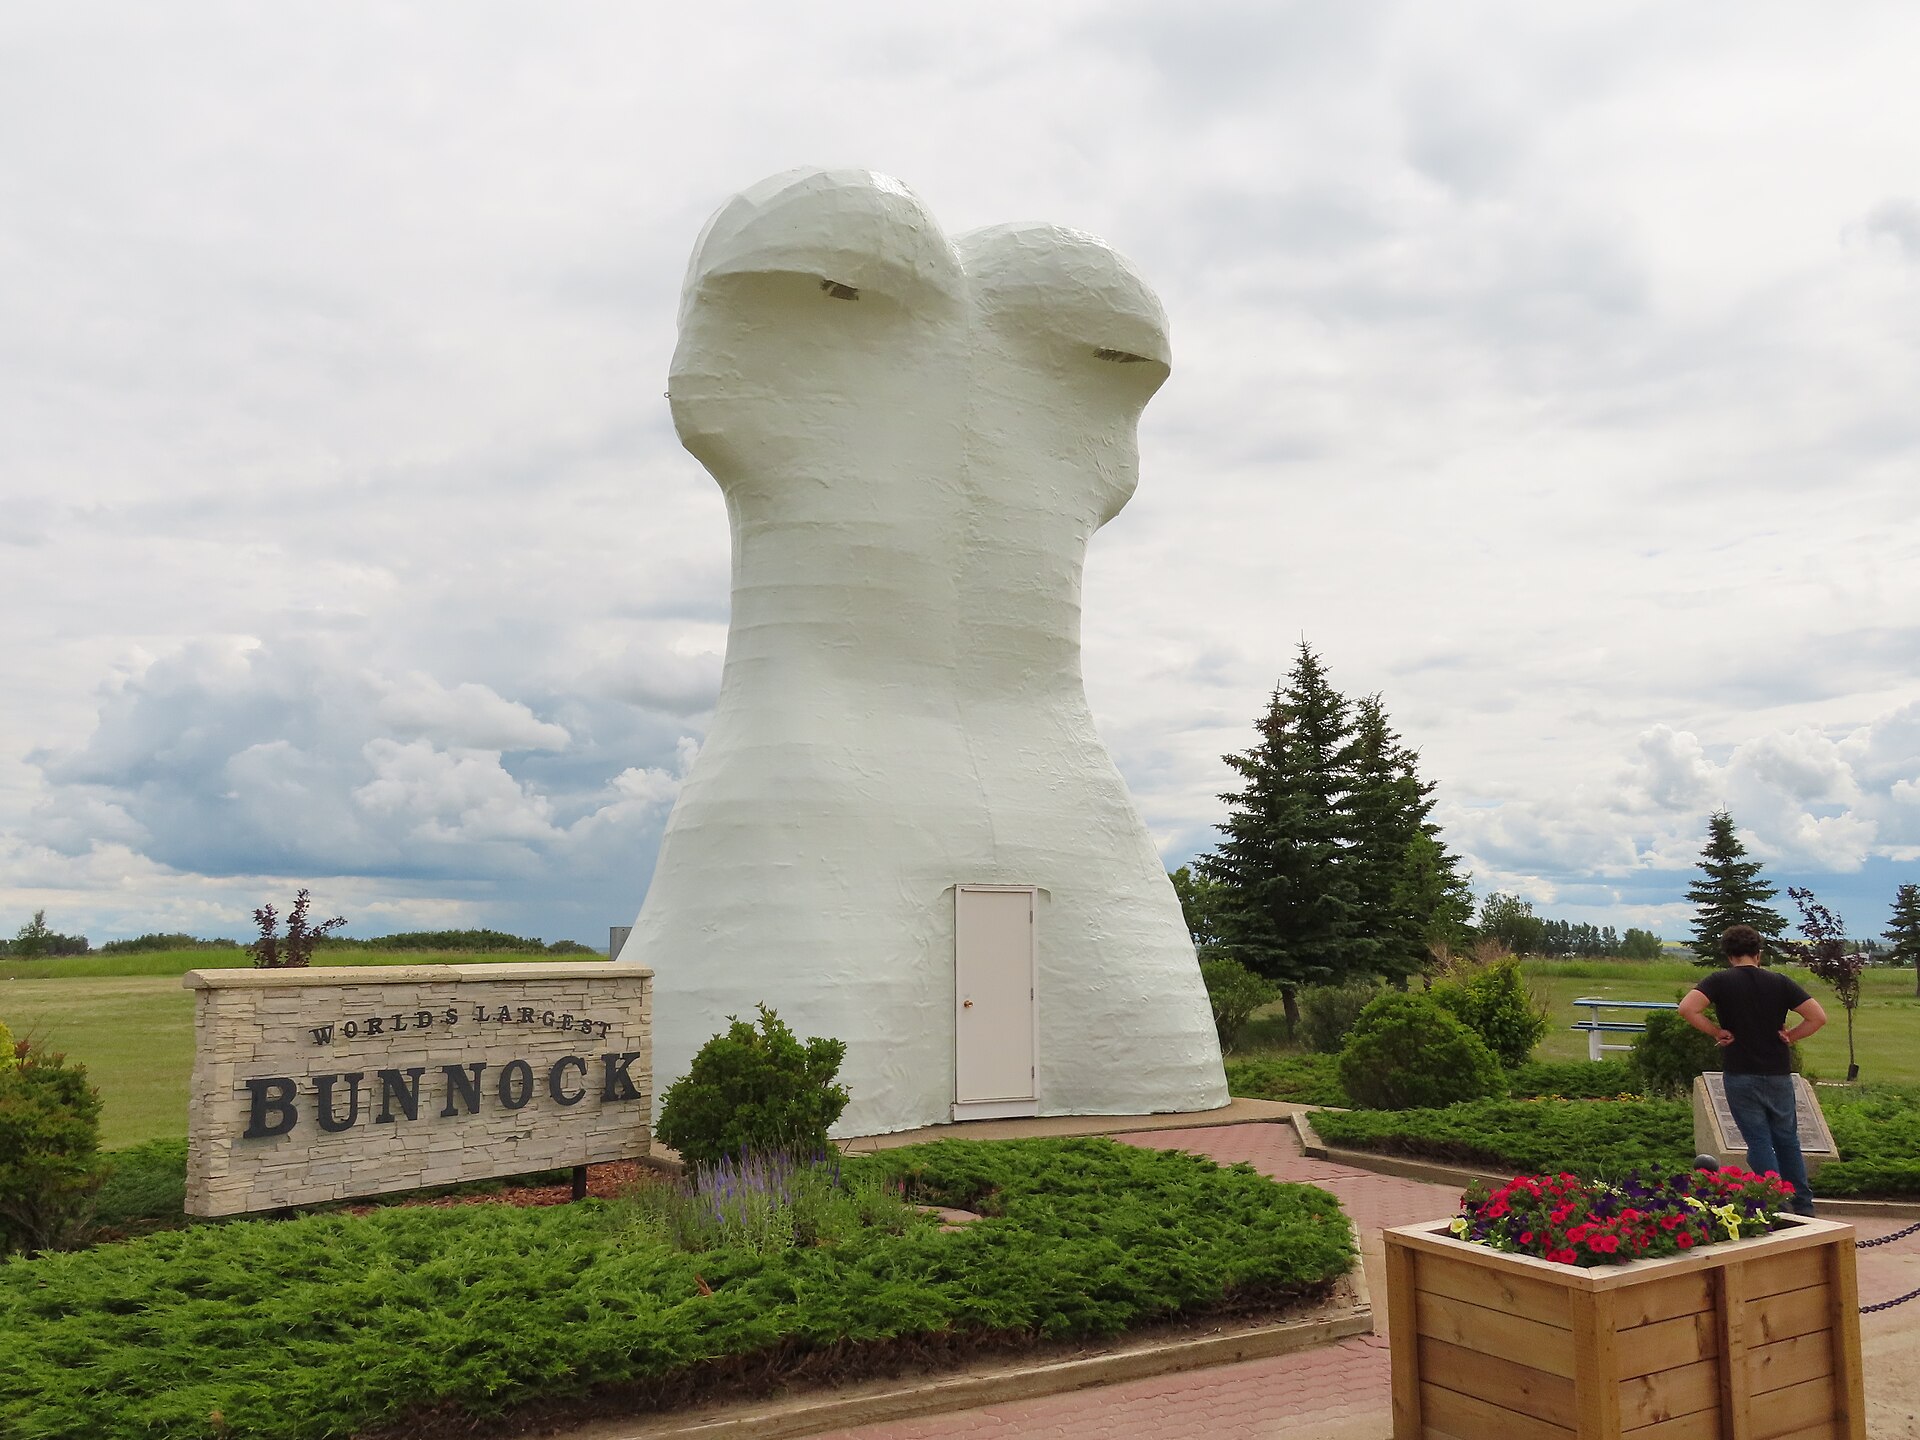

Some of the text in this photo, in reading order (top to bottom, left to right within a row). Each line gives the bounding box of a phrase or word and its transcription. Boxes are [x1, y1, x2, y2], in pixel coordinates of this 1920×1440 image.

[309, 1004, 612, 1046] WORLDS LARGEST
[243, 1051, 642, 1140] BUNNOCK
